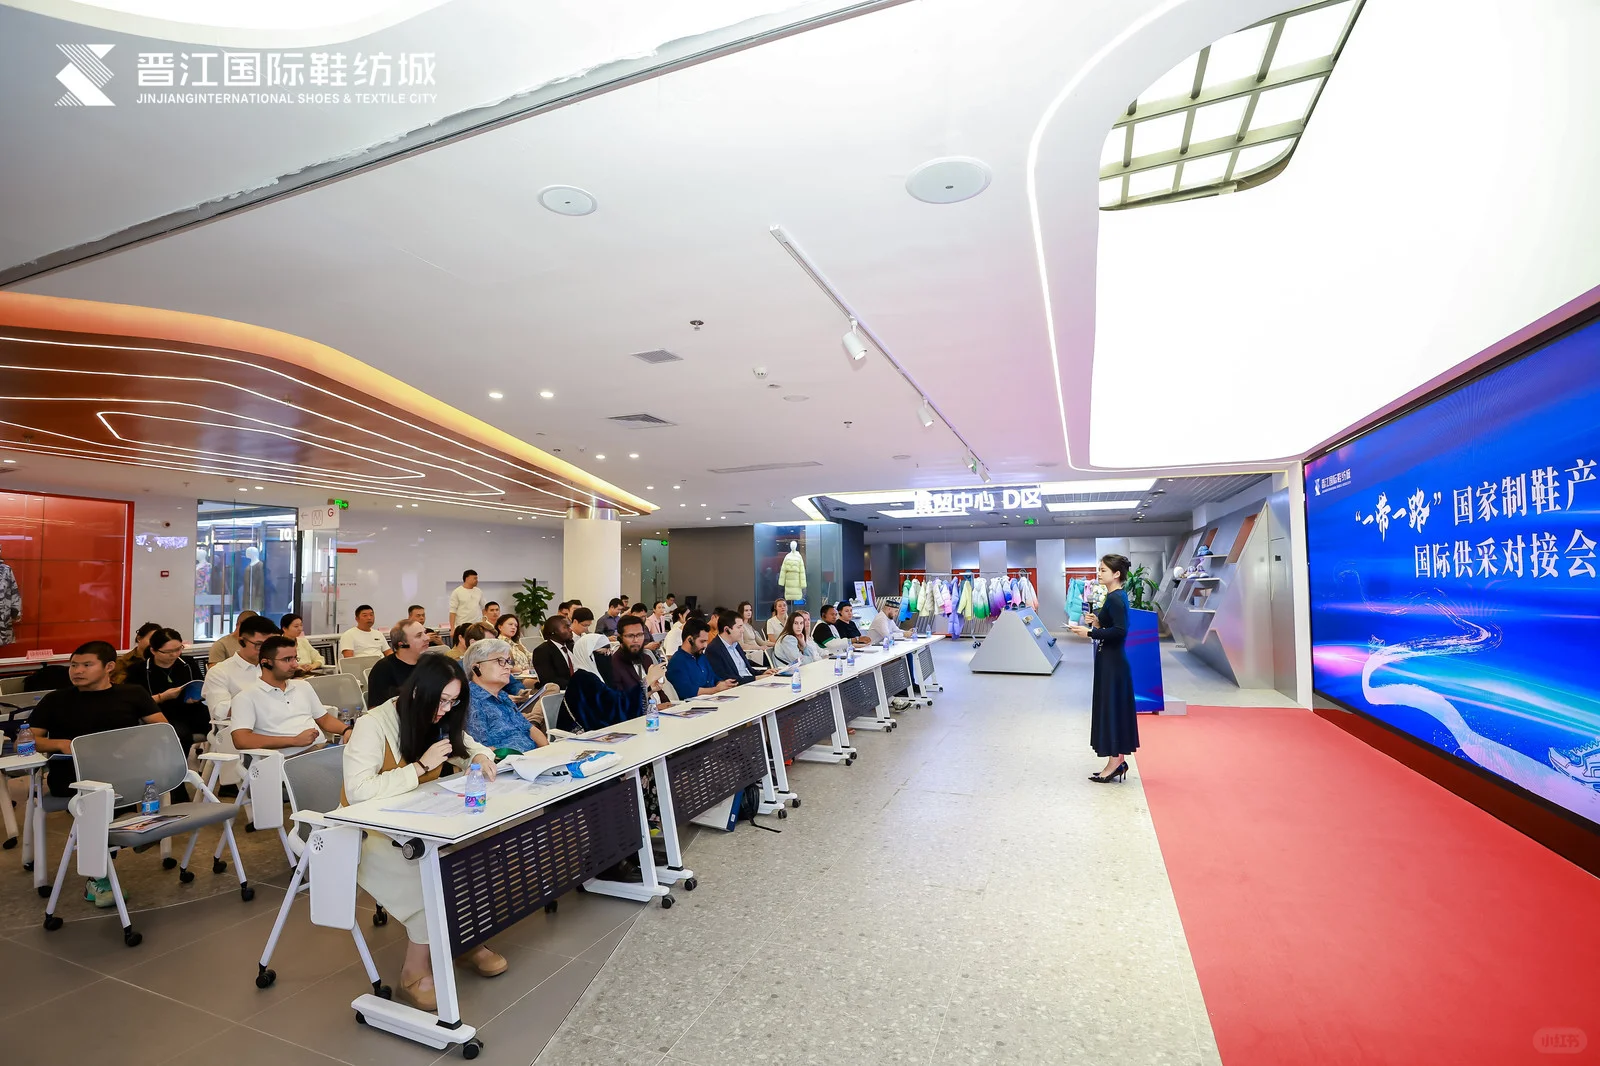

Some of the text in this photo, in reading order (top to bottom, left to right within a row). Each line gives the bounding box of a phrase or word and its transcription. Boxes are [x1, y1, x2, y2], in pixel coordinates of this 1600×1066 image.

[327, 508, 334, 517] G
[1414, 528, 1598, 579] 国际供采对接会
